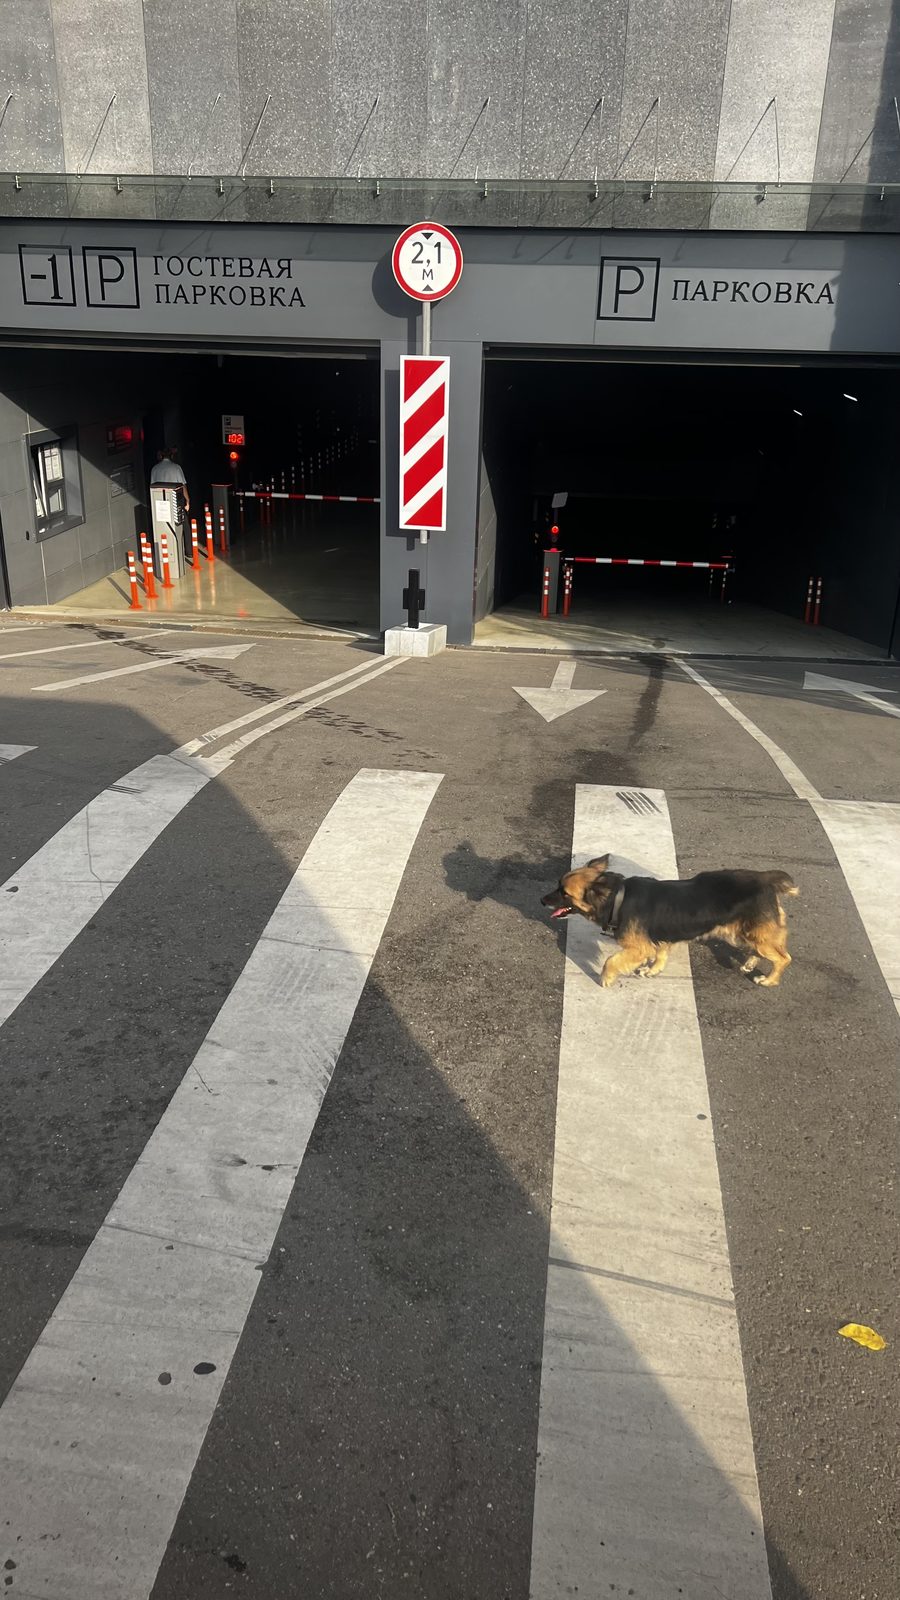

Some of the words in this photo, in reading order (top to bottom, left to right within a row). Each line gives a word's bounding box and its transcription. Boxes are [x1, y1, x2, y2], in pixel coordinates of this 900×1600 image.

[152, 255, 293, 279] ГОСТЕВАЯ
[411, 241, 441, 267] 2,1
[30, 253, 63, 300] -1
[97, 255, 125, 301] P
[613, 265, 645, 313] P
[154, 283, 306, 308] ПАРКОВКА
[671, 279, 835, 305] ПАРКОВКА
